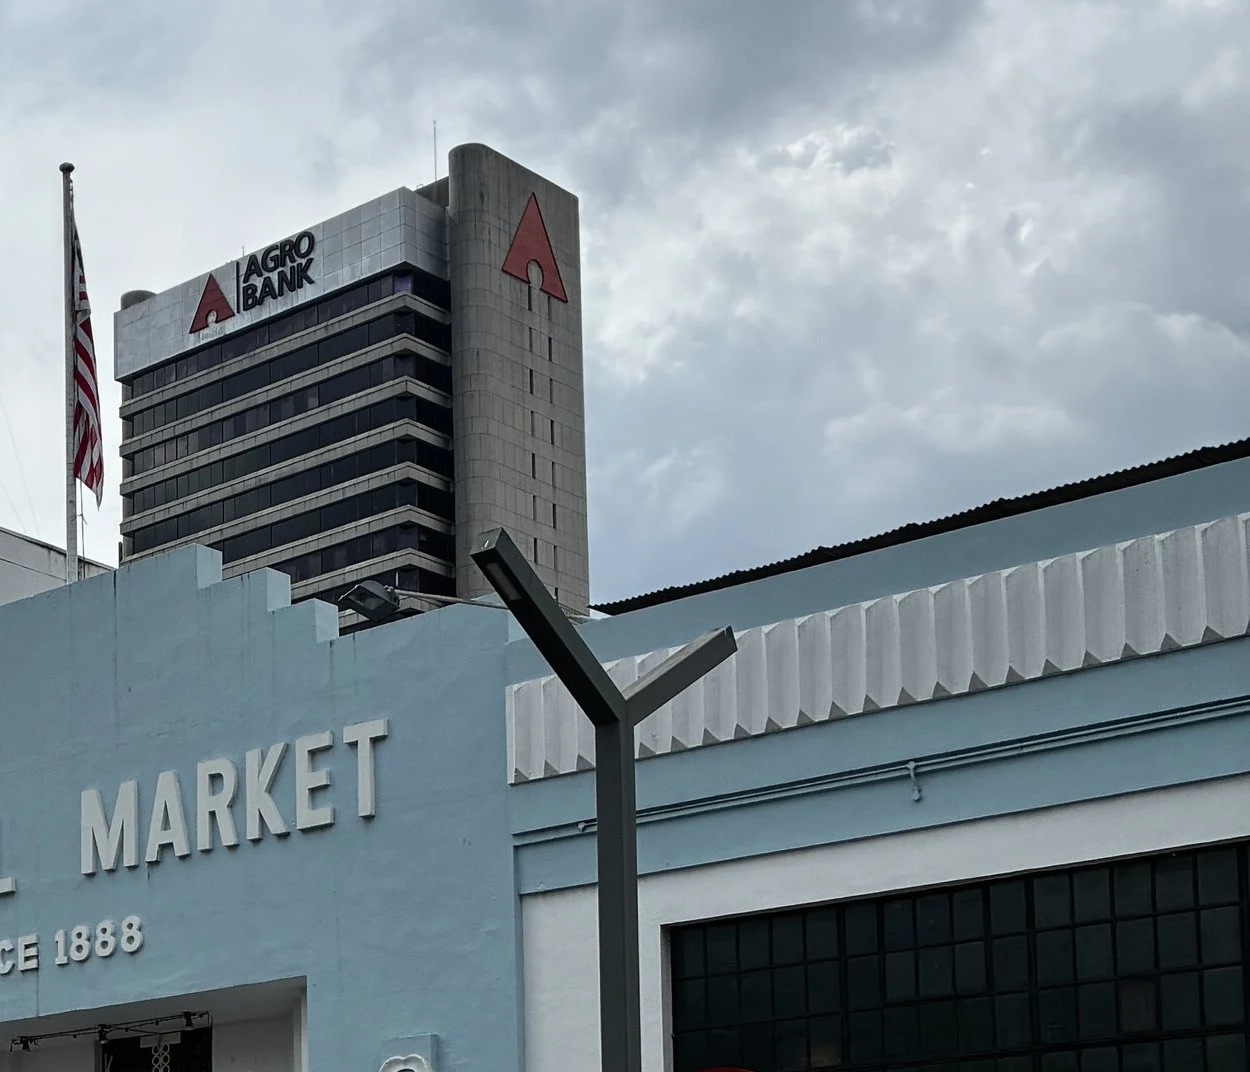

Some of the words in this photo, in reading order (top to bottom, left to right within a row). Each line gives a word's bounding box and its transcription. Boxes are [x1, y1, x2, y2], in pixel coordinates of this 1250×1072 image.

[242, 257, 316, 311] BANK
[243, 231, 315, 284] AGRO
[81, 717, 390, 877] MARKET
[54, 915, 144, 966] 1888
